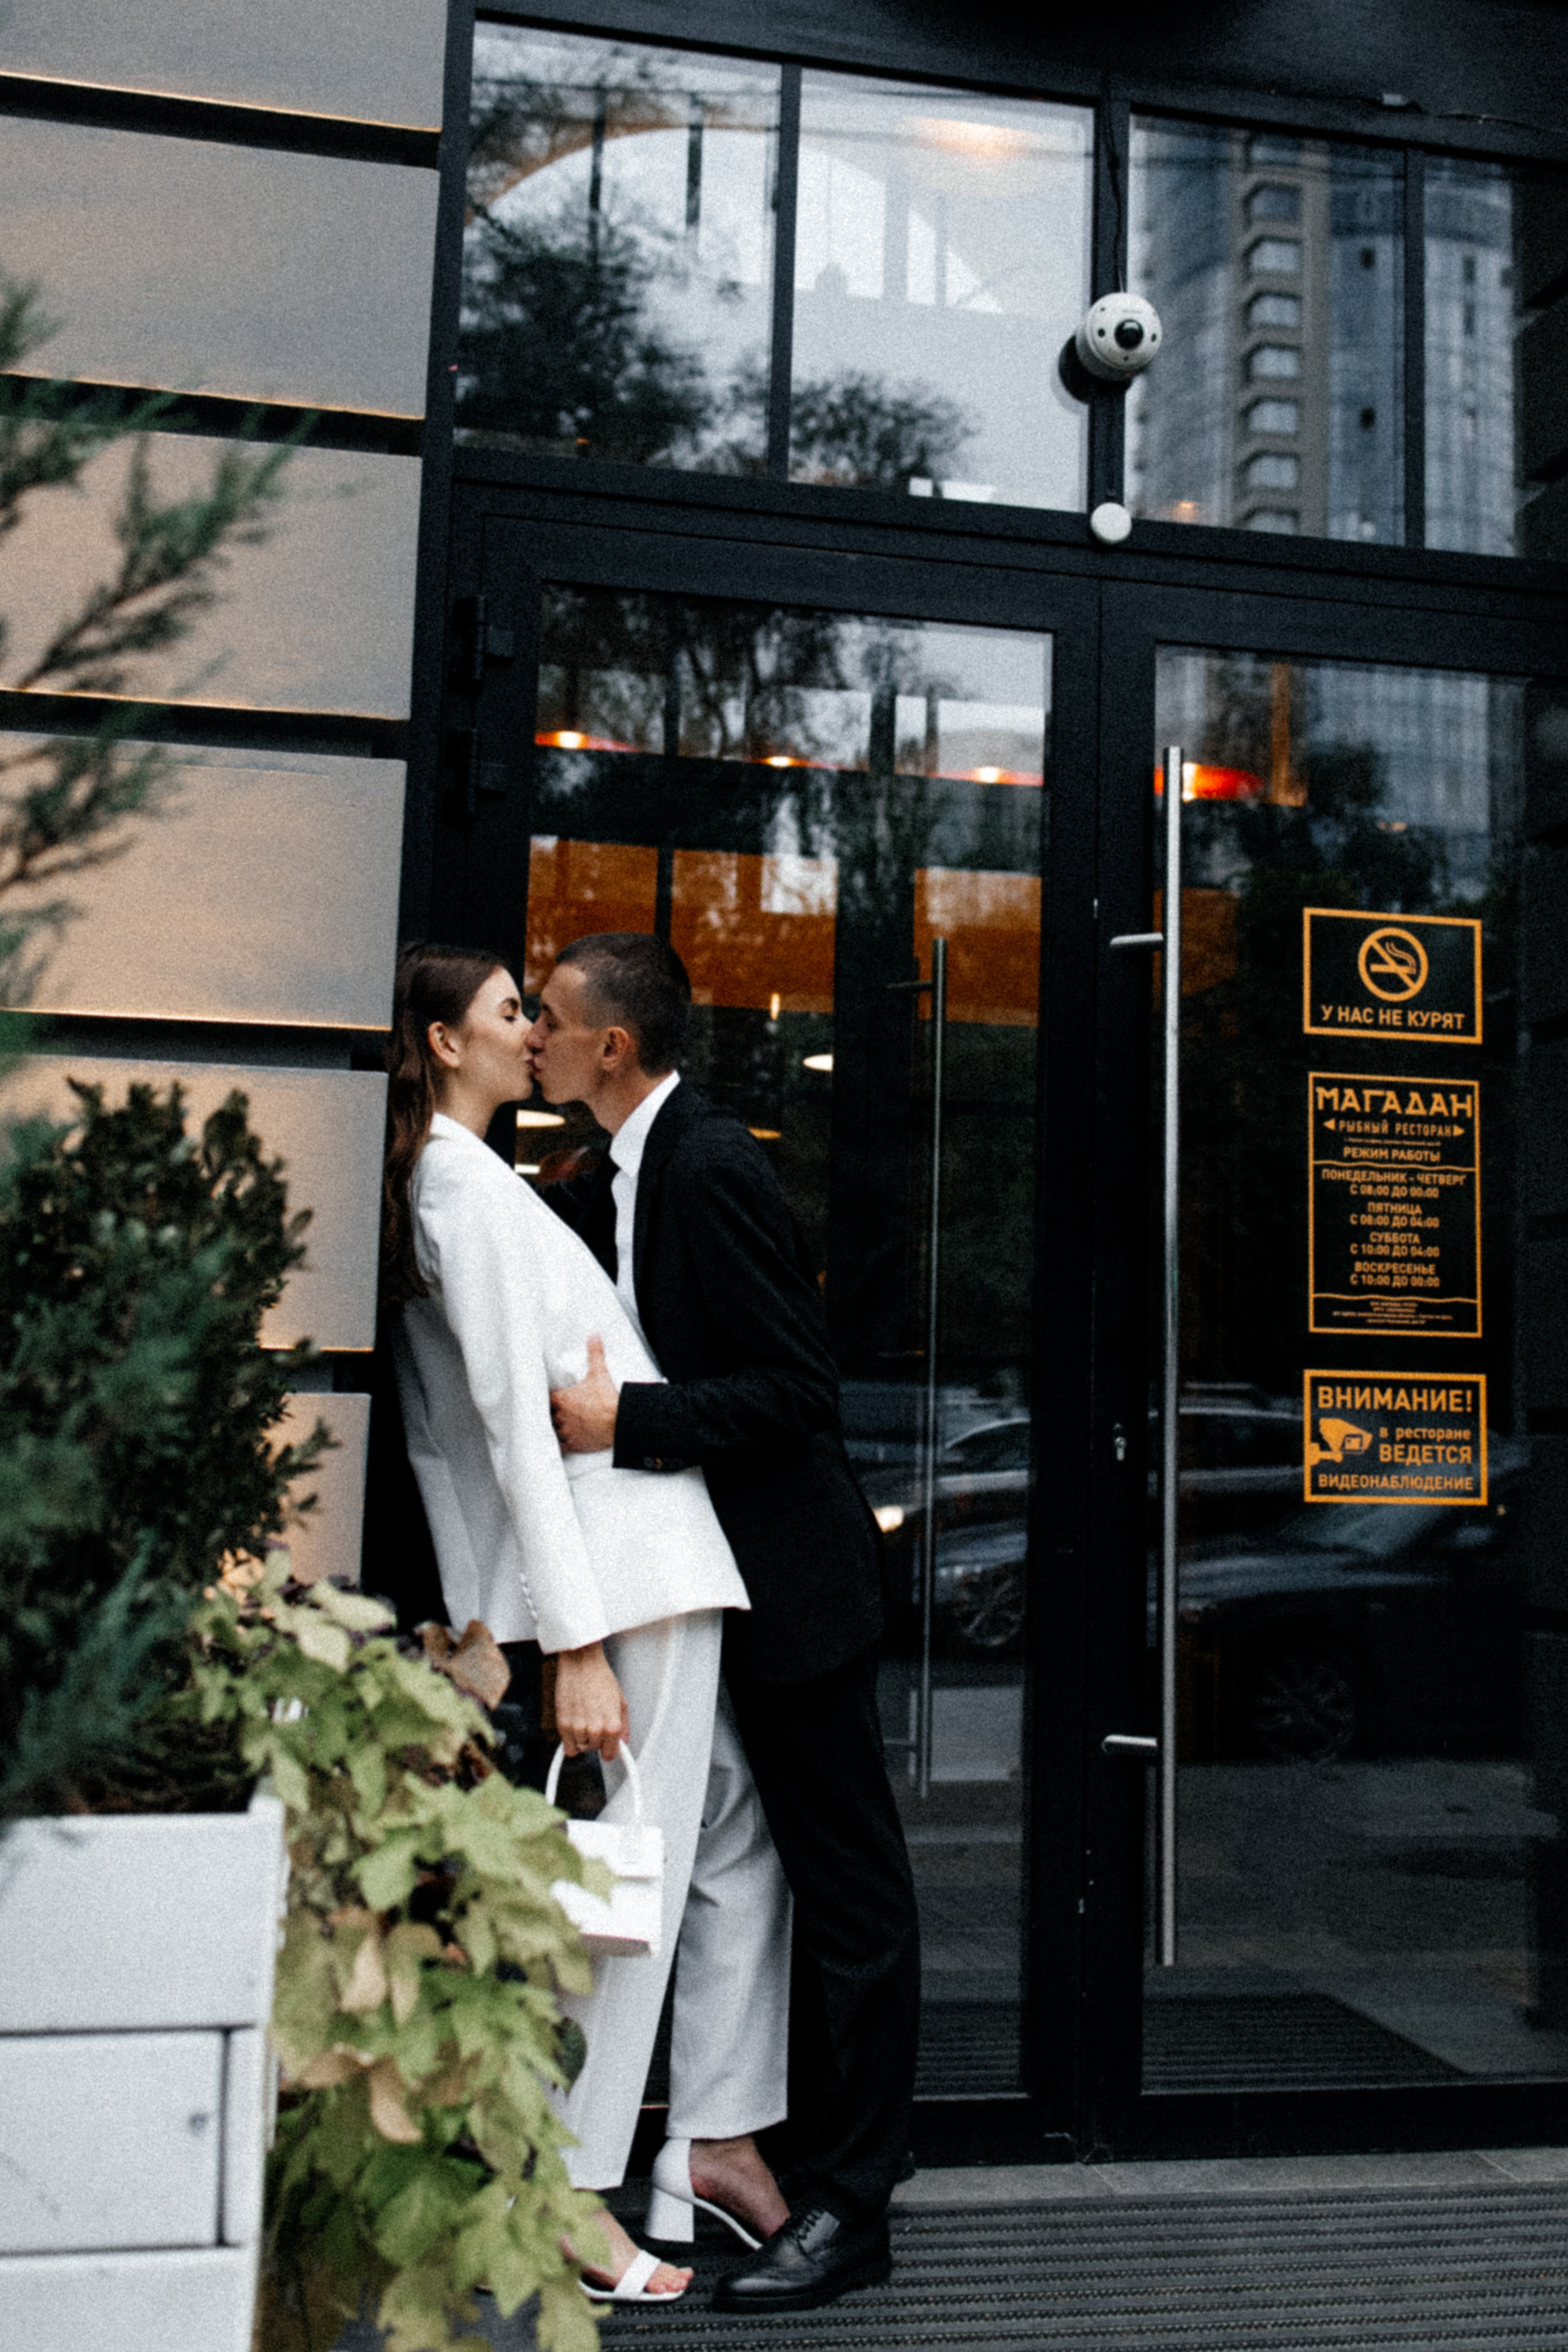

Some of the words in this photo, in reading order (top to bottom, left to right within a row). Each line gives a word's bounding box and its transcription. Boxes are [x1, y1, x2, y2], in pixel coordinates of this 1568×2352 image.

[1321, 1005, 1333, 1022] У
[1338, 1006, 1374, 1024] НАС
[1379, 1009, 1403, 1026] НЕ
[1408, 1011, 1465, 1029] КУРЯТ
[1316, 1087, 1472, 1118] МАГАДАН
[1339, 1119, 1389, 1134] РЫБНЫЙ
[1395, 1123, 1452, 1137] РЕСТОРАН
[1343, 1147, 1389, 1159] РЕЖИМ
[1392, 1149, 1441, 1162] РАБОТЫ
[1322, 1169, 1407, 1183] ПОНЕДЕЛЬНИК
[1417, 1173, 1467, 1185] ЧЕТВЕРГ
[1350, 1184, 1357, 1194] С
[1391, 1186, 1408, 1197] ДО
[1368, 1202, 1422, 1215] ПЯТНИЦА
[1350, 1214, 1357, 1224] С
[1391, 1216, 1408, 1227] ДО
[1370, 1232, 1420, 1244] СУББОТА
[1350, 1243, 1357, 1254] С
[1362, 1244, 1390, 1255] 10:00
[1392, 1245, 1408, 1257] ДО
[1354, 1261, 1435, 1275] ВОСКРЕСЕНЬЕ
[1350, 1274, 1357, 1285] С
[1362, 1275, 1390, 1286] 10:00
[1392, 1276, 1408, 1287] ДО
[1318, 1385, 1472, 1412] ВНИМАНИЕ!
[1379, 1427, 1389, 1438] в
[1396, 1428, 1472, 1442] ресторане
[1379, 1444, 1472, 1466] ВЕДЕТСЯ
[1318, 1474, 1474, 1491] ВИДЕОНАБЛЮДЕНИЕ
